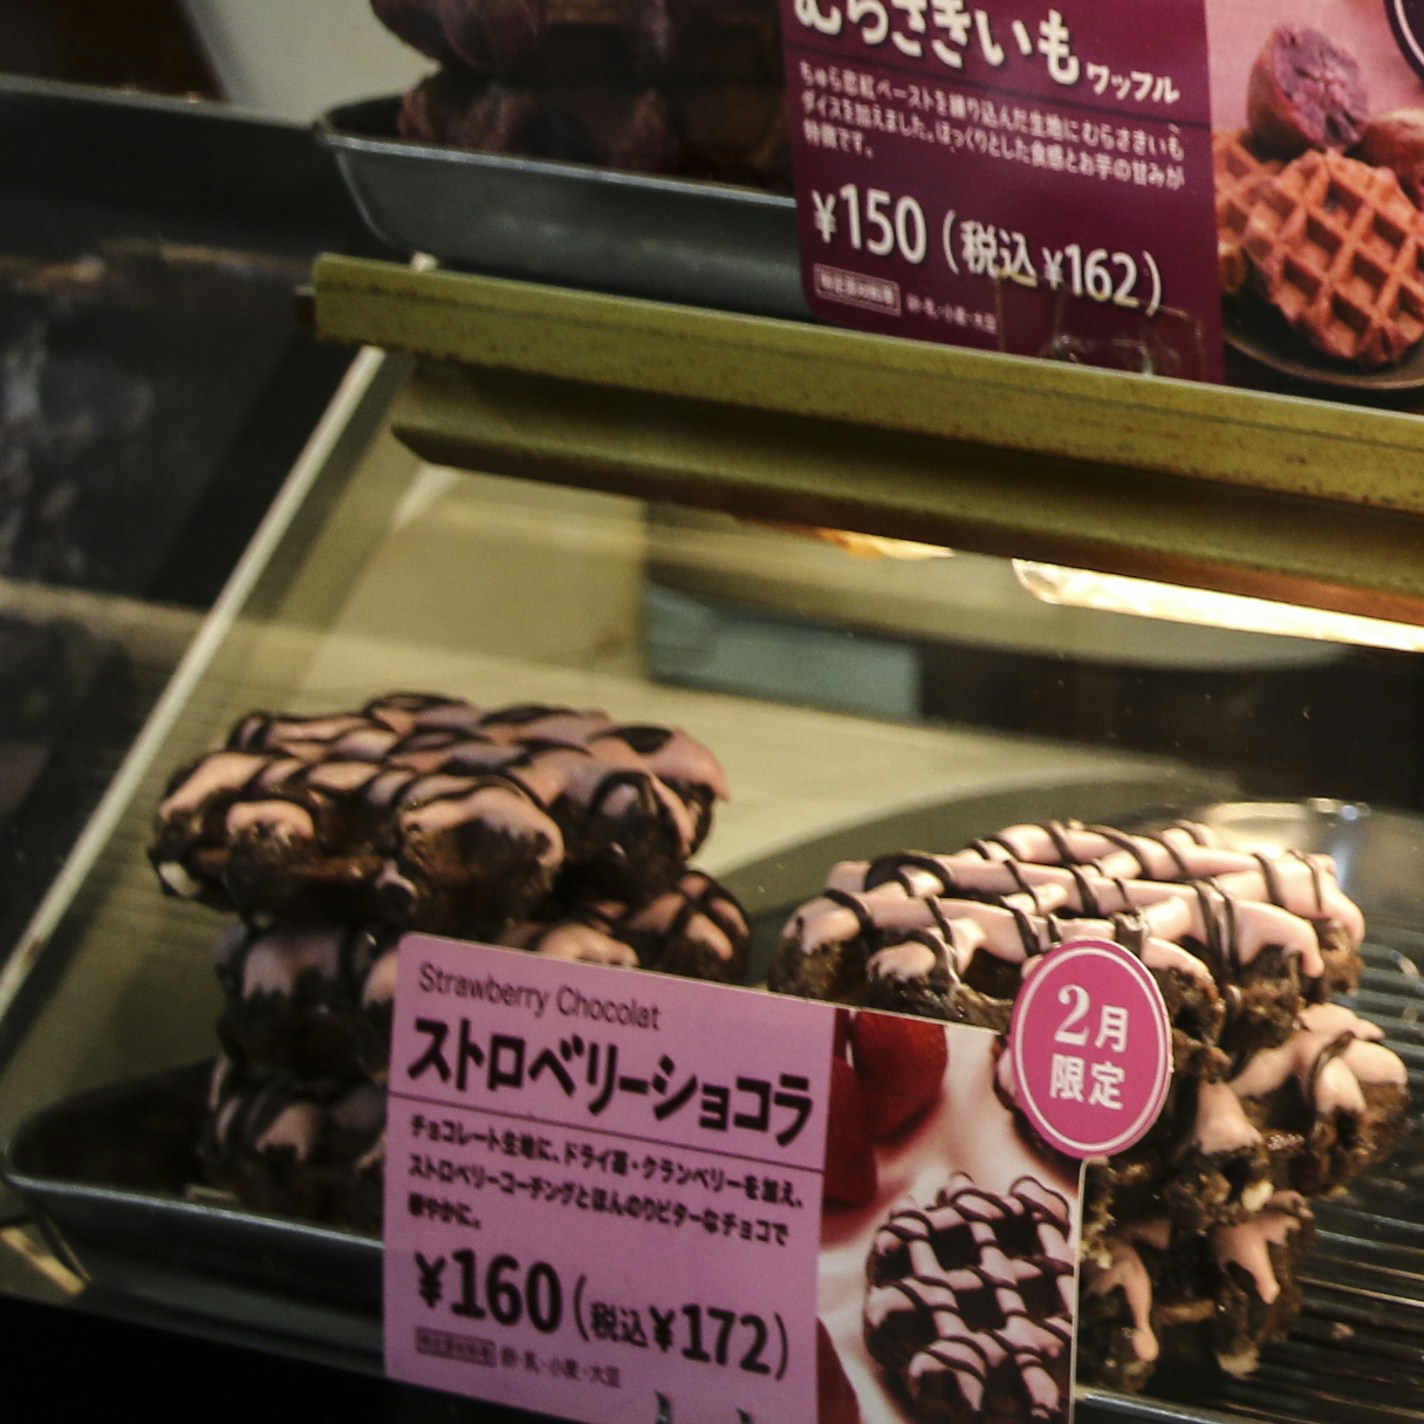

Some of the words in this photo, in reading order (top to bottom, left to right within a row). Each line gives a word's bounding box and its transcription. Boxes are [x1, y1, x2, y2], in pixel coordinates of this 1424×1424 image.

[1086, 63, 1180, 105] ワッフル
[418, 962, 551, 1016] Strawberry
[556, 984, 662, 1032] Chocolat
[1053, 984, 1129, 1052] 2月
[406, 1015, 813, 1149] ストロベリーショコラ
[1050, 1053, 1126, 1110] 限定
